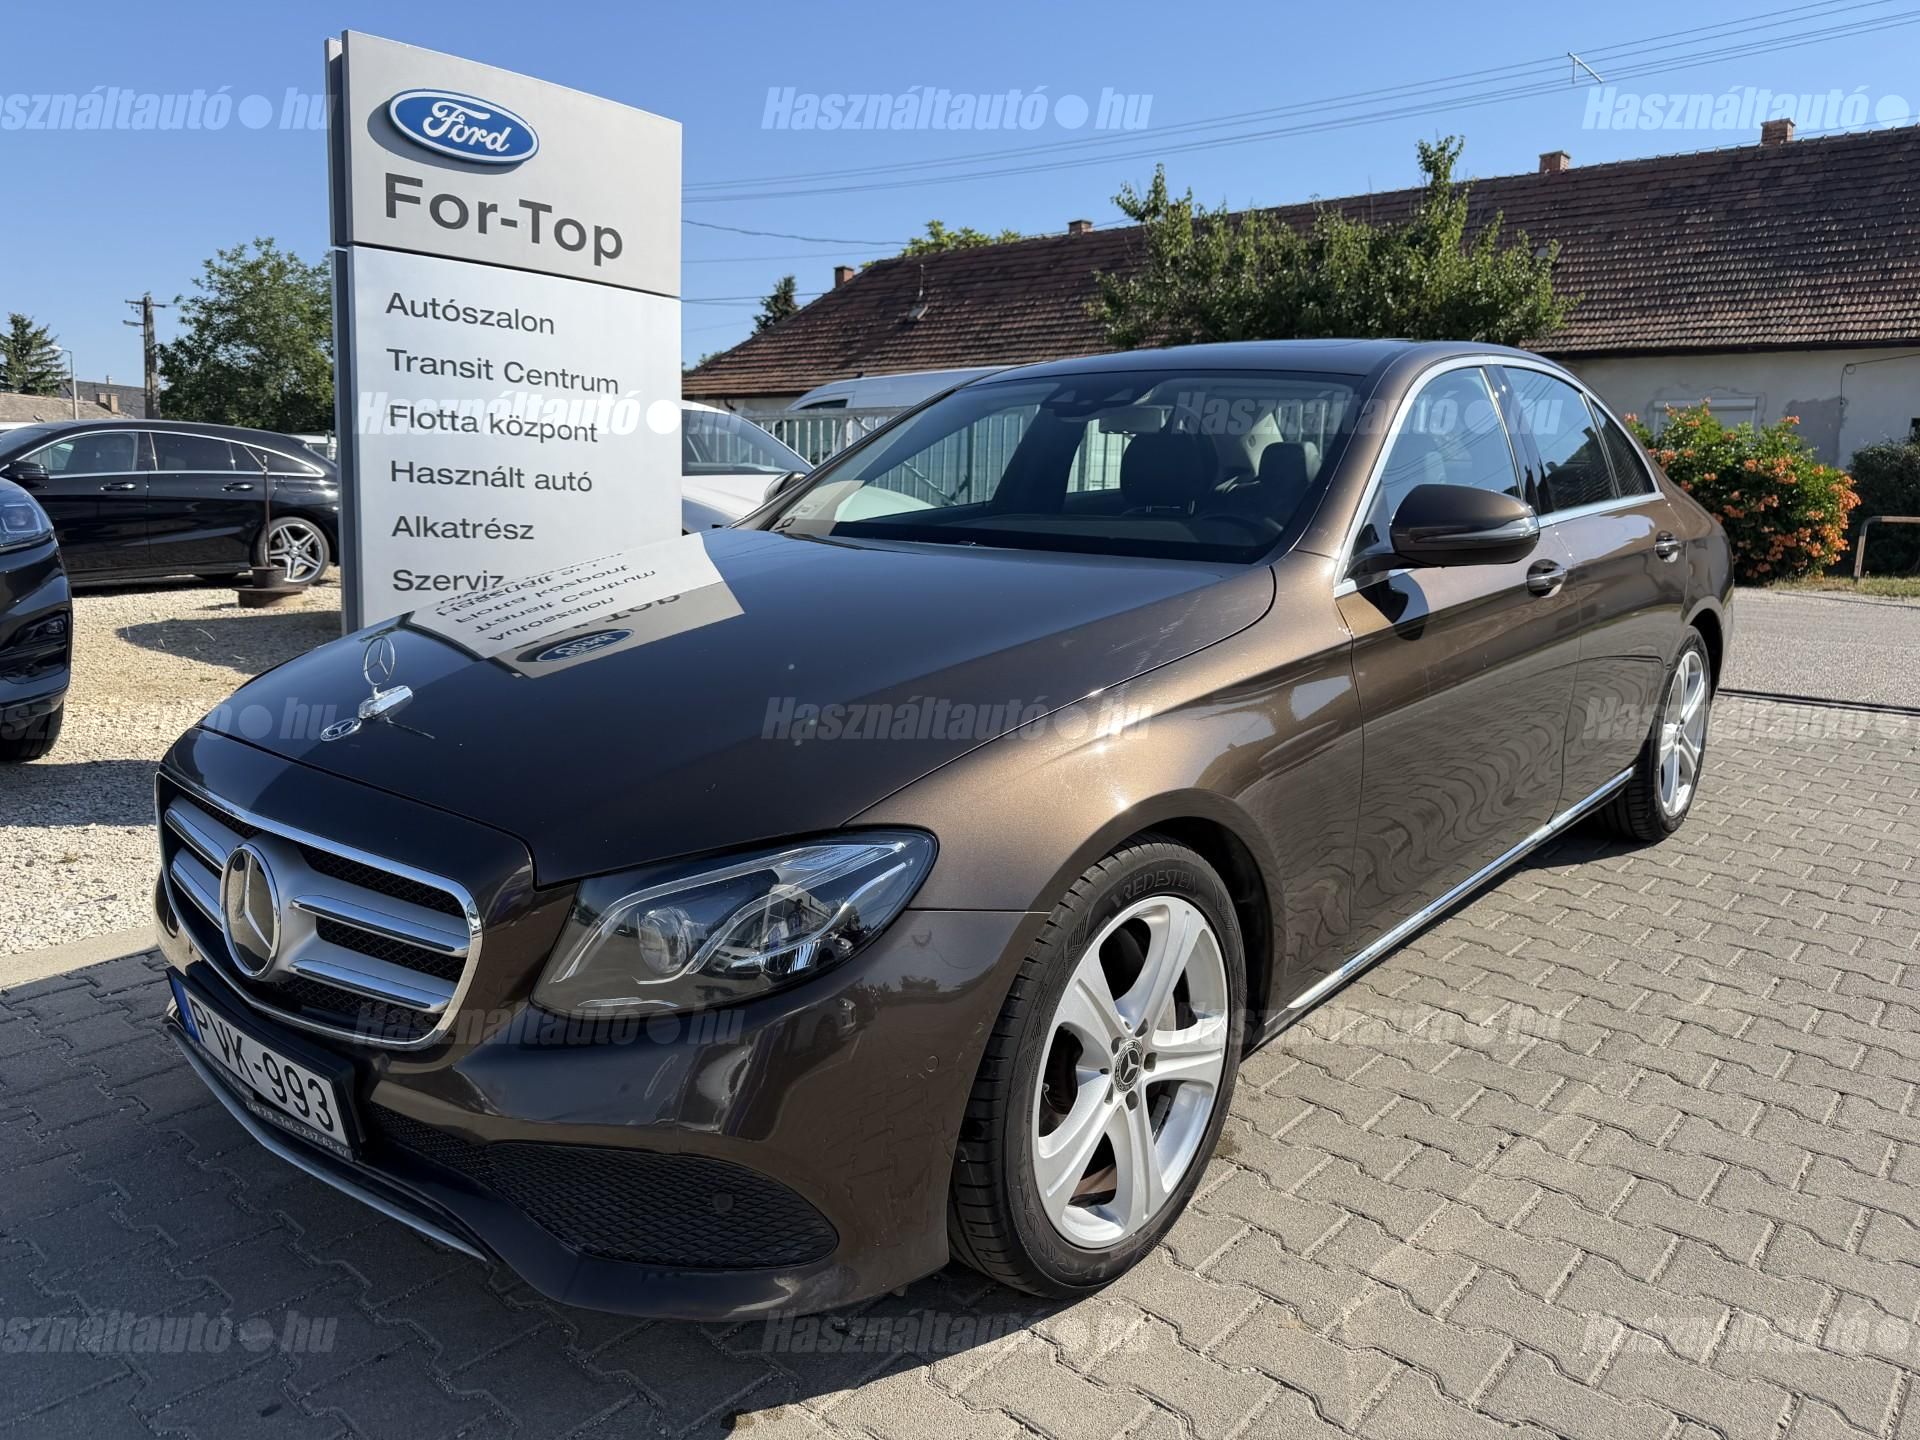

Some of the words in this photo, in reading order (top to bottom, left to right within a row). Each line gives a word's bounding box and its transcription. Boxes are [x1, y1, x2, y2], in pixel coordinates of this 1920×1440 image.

[422, 101, 511, 153] Ford
[385, 172, 623, 267] For-Top
[385, 292, 555, 334] Autószalon
[386, 348, 494, 380] Transit
[503, 360, 619, 395] Centrum
[389, 404, 479, 433] Flotta
[489, 413, 598, 443] központ
[390, 460, 525, 489] Használt
[534, 472, 593, 492] autó
[391, 515, 535, 540] Alkatrész
[392, 569, 504, 593] Szerviz
[189, 998, 334, 1132] PVK-993
